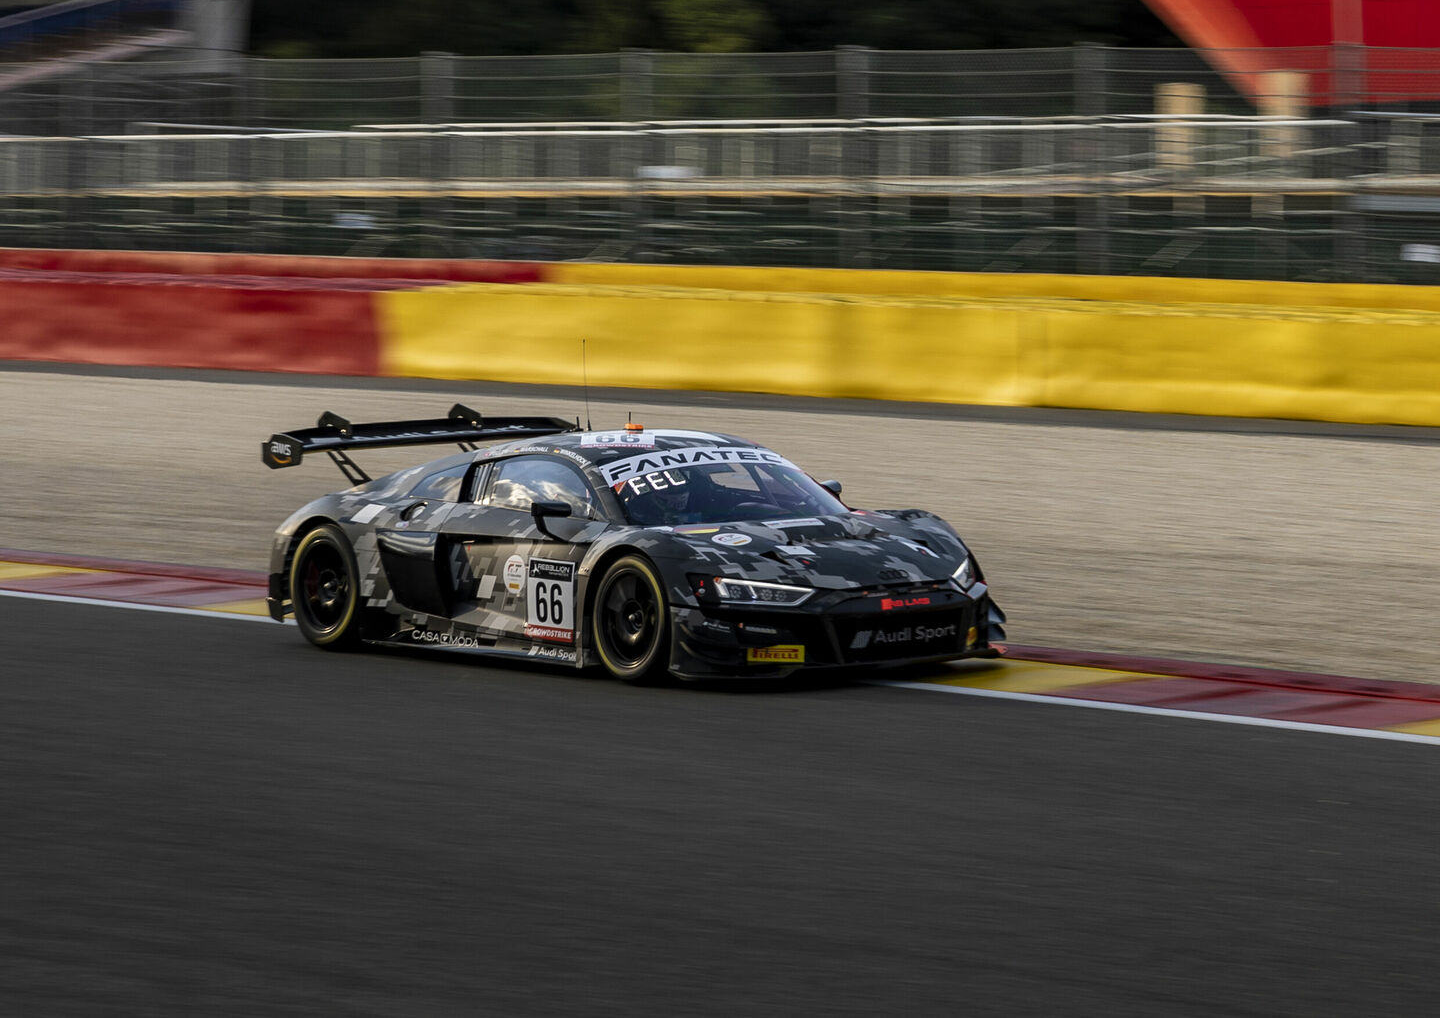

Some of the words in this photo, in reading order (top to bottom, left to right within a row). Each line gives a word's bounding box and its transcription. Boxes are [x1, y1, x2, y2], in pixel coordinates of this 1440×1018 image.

[596, 433, 640, 443] 66
[271, 441, 292, 456] aws
[609, 450, 783, 482] FANATEC
[628, 470, 686, 495] FEL
[535, 581, 563, 624] 66
[412, 629, 440, 642] CASA
[450, 635, 479, 648] MODA
[530, 627, 571, 639] CROWDSTRIKE
[873, 627, 912, 643] Audi
[915, 624, 956, 642] Sport
[539, 646, 557, 657] Audi
[752, 647, 799, 659] PIRELLI
